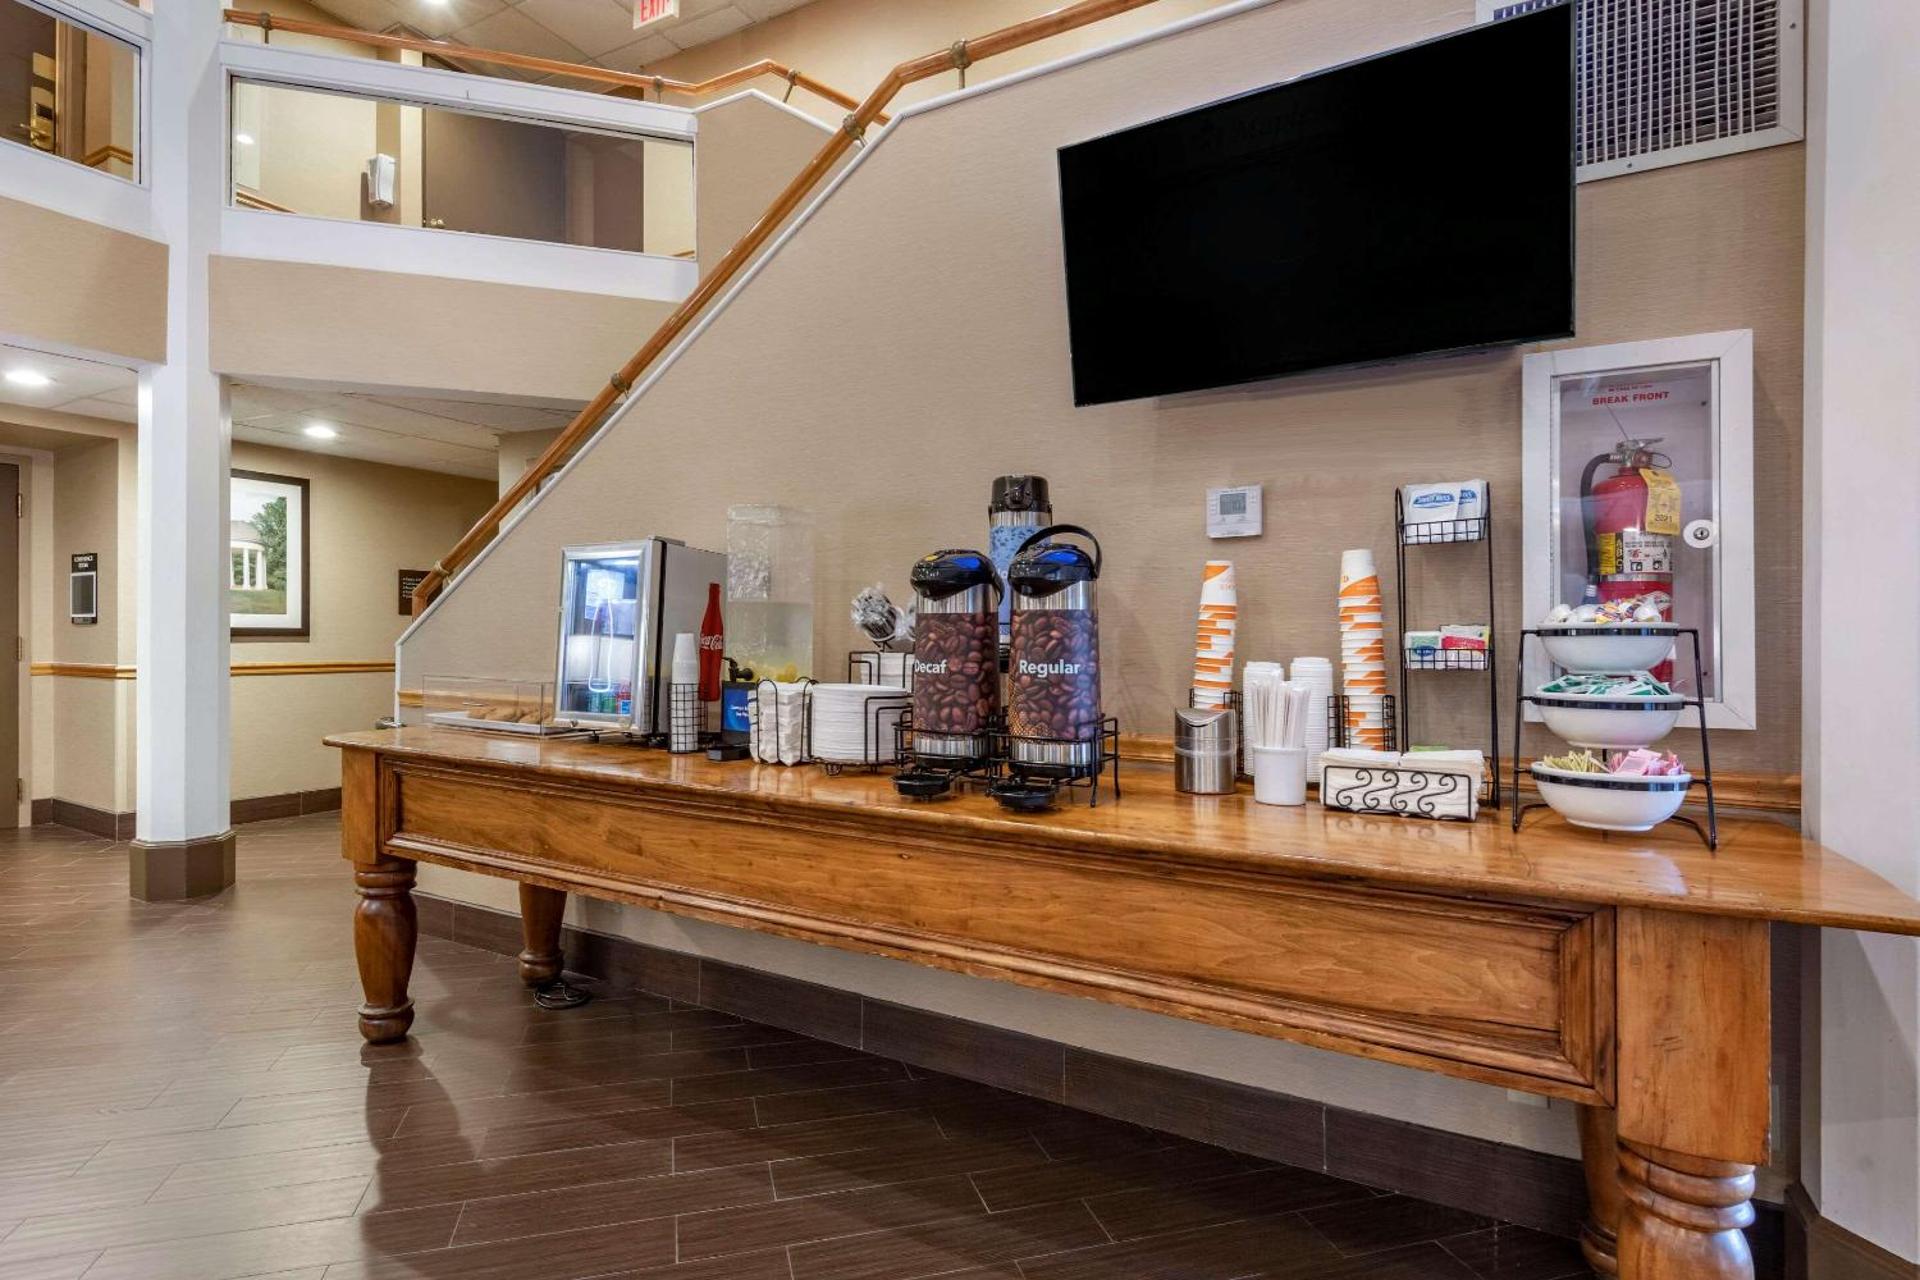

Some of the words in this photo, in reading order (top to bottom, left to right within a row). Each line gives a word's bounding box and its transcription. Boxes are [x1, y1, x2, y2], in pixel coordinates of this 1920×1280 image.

[1592, 395, 1628, 405] BREAK
[1633, 391, 1670, 401] FRONT
[914, 658, 948, 674] Decaf
[1019, 659, 1081, 676] Regular
